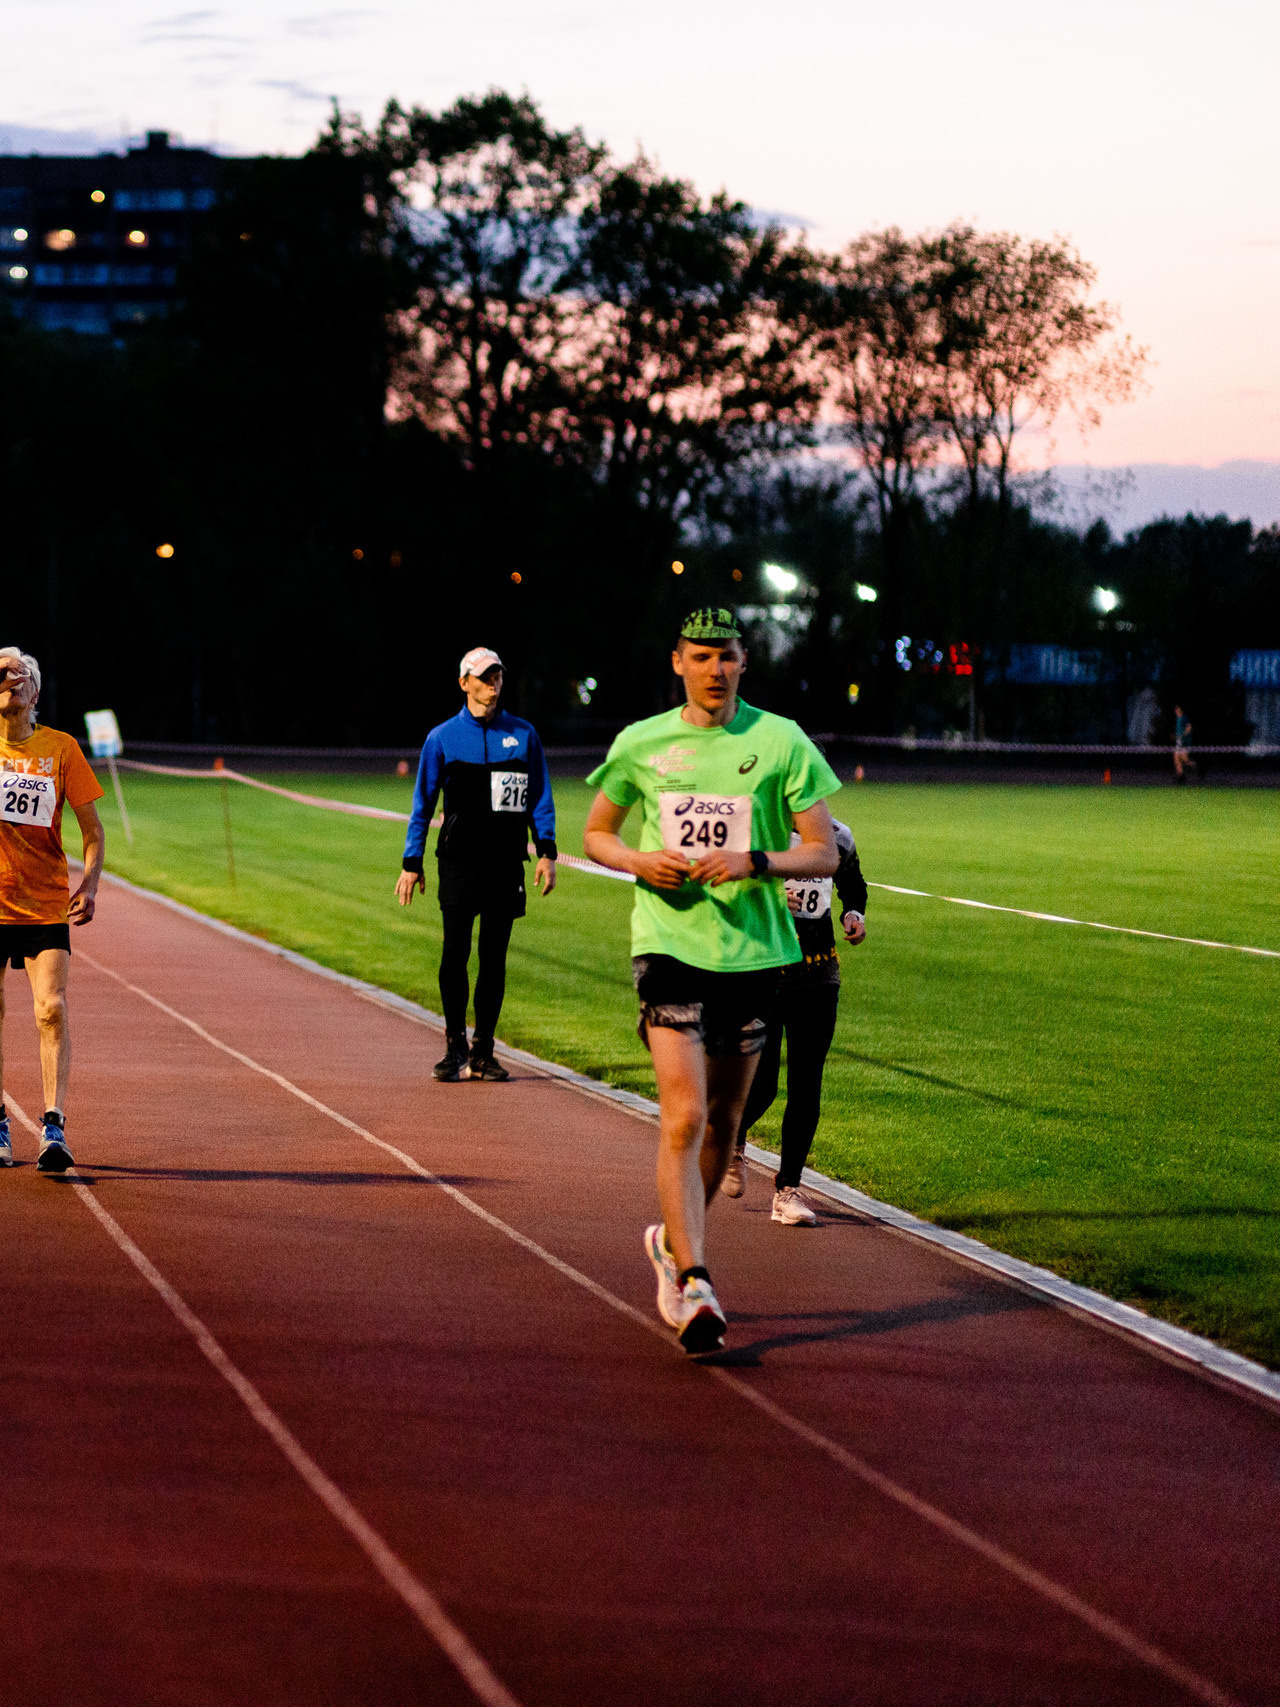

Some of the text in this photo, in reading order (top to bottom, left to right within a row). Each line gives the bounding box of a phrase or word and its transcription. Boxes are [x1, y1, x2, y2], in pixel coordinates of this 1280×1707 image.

[18, 778, 48, 792] asics
[501, 786, 528, 807] 216
[4, 791, 40, 817] 261
[694, 801, 736, 816] asics
[680, 819, 728, 848] 249
[786, 887, 820, 913] 18
